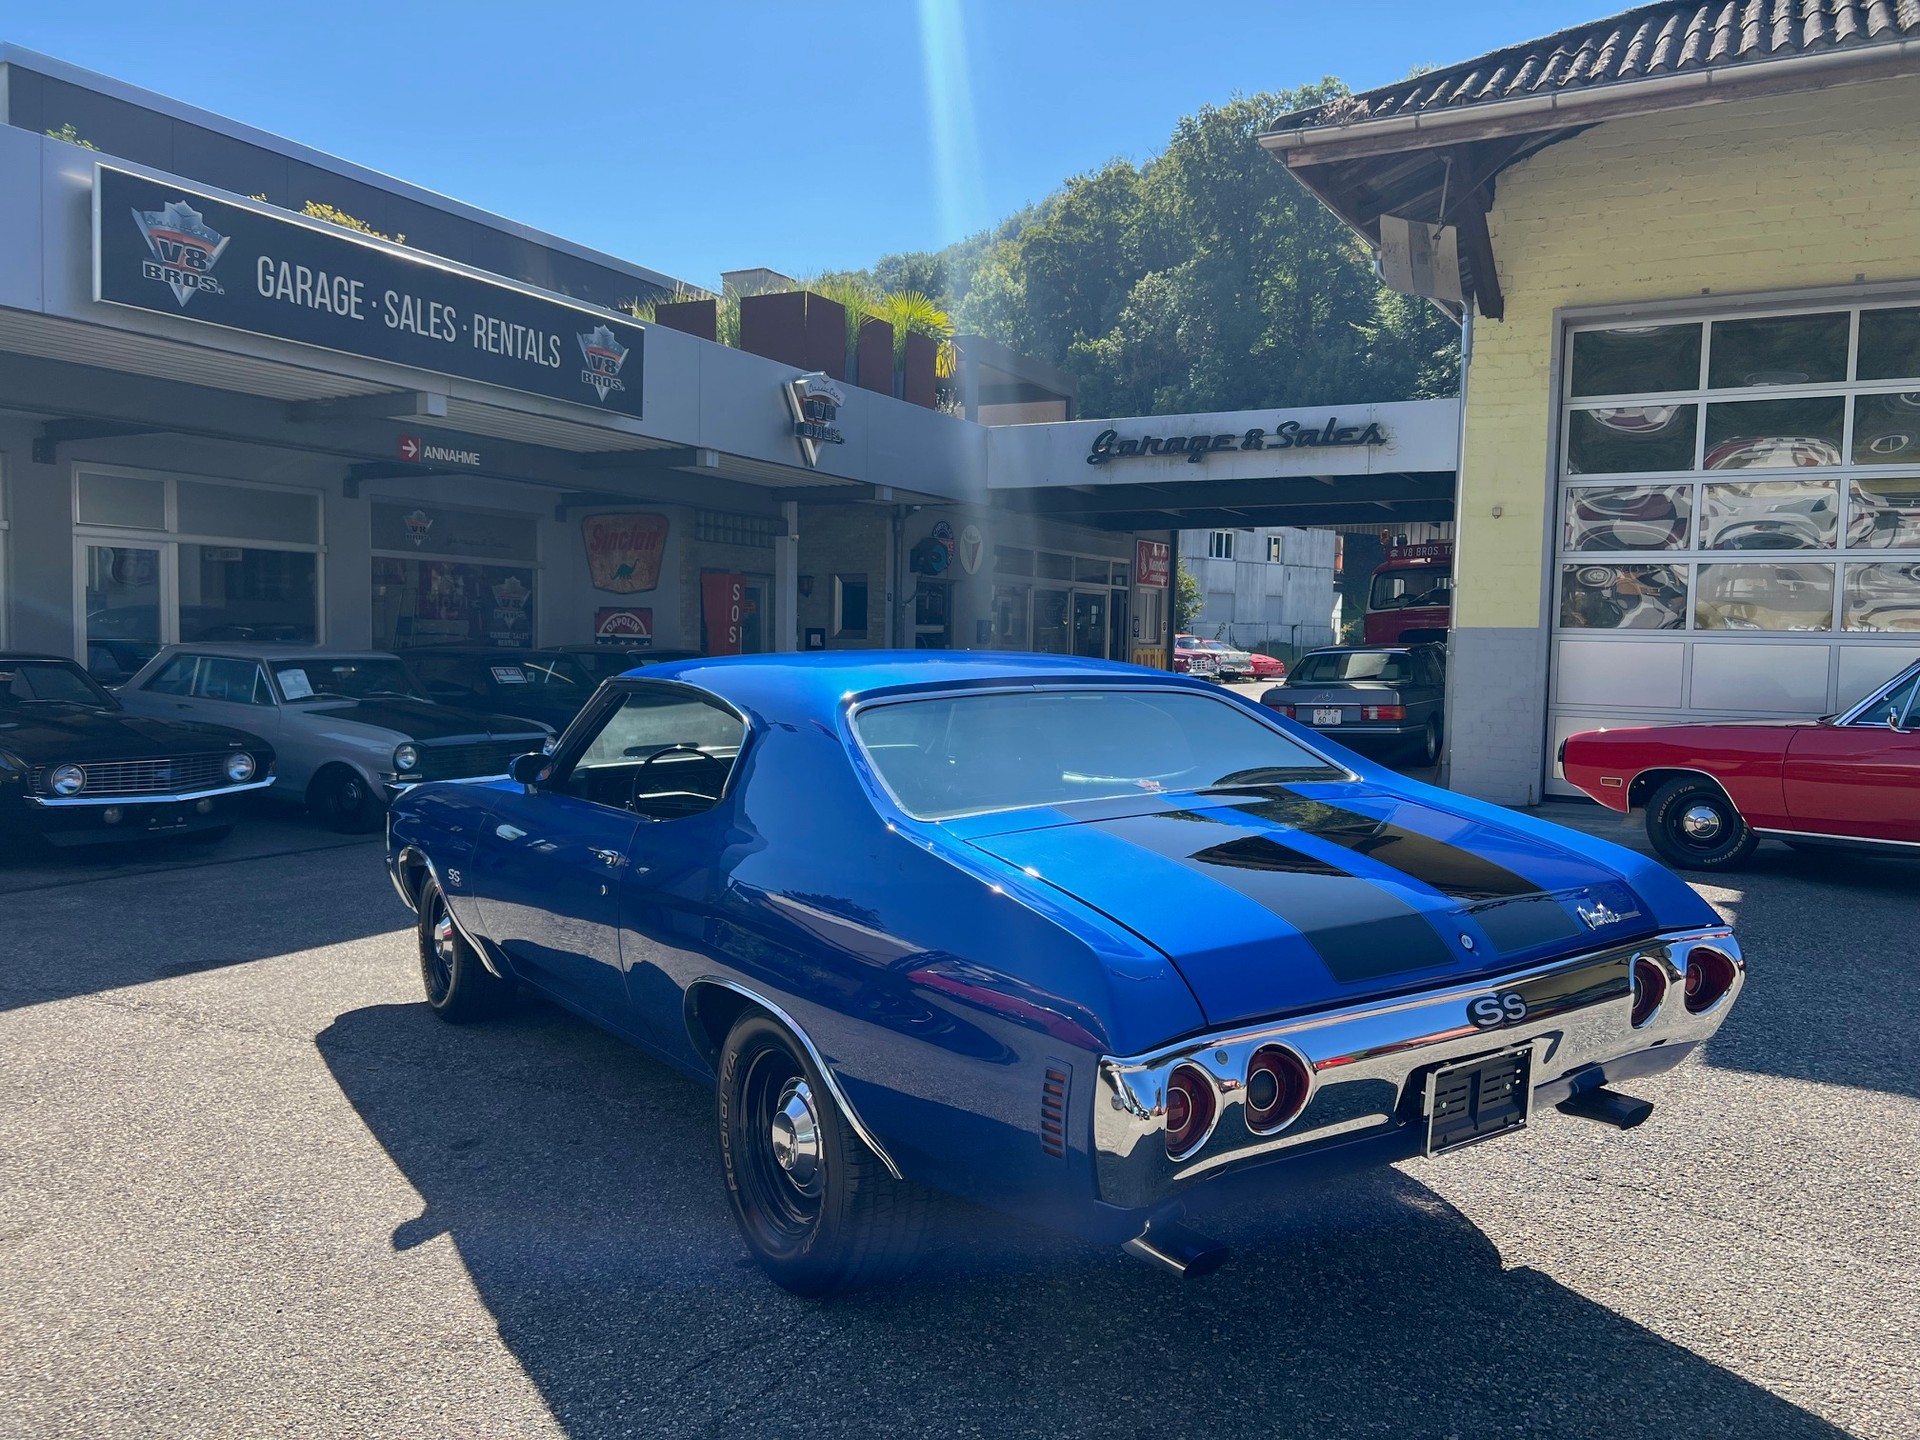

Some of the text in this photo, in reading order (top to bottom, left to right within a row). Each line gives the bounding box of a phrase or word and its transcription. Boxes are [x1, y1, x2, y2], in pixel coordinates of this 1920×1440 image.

[156, 236, 209, 272] V8
[142, 260, 226, 296] BROS.
[257, 255, 365, 320] GARAGE
[384, 290, 457, 343] SALES
[473, 313, 561, 369] RENTALS
[589, 353, 618, 376] V8
[424, 446, 481, 466] ANNAHME
[1087, 417, 1388, 464] Garage & Sales
[1403, 548, 1414, 557] V8
[605, 615, 641, 633] DAPOLIN
[728, 583, 741, 643] SOS
[1657, 784, 1695, 823] Radial T/A
[448, 868, 460, 882] SS
[1474, 993, 1526, 1026] SS
[718, 1050, 738, 1192] Radial T/A
